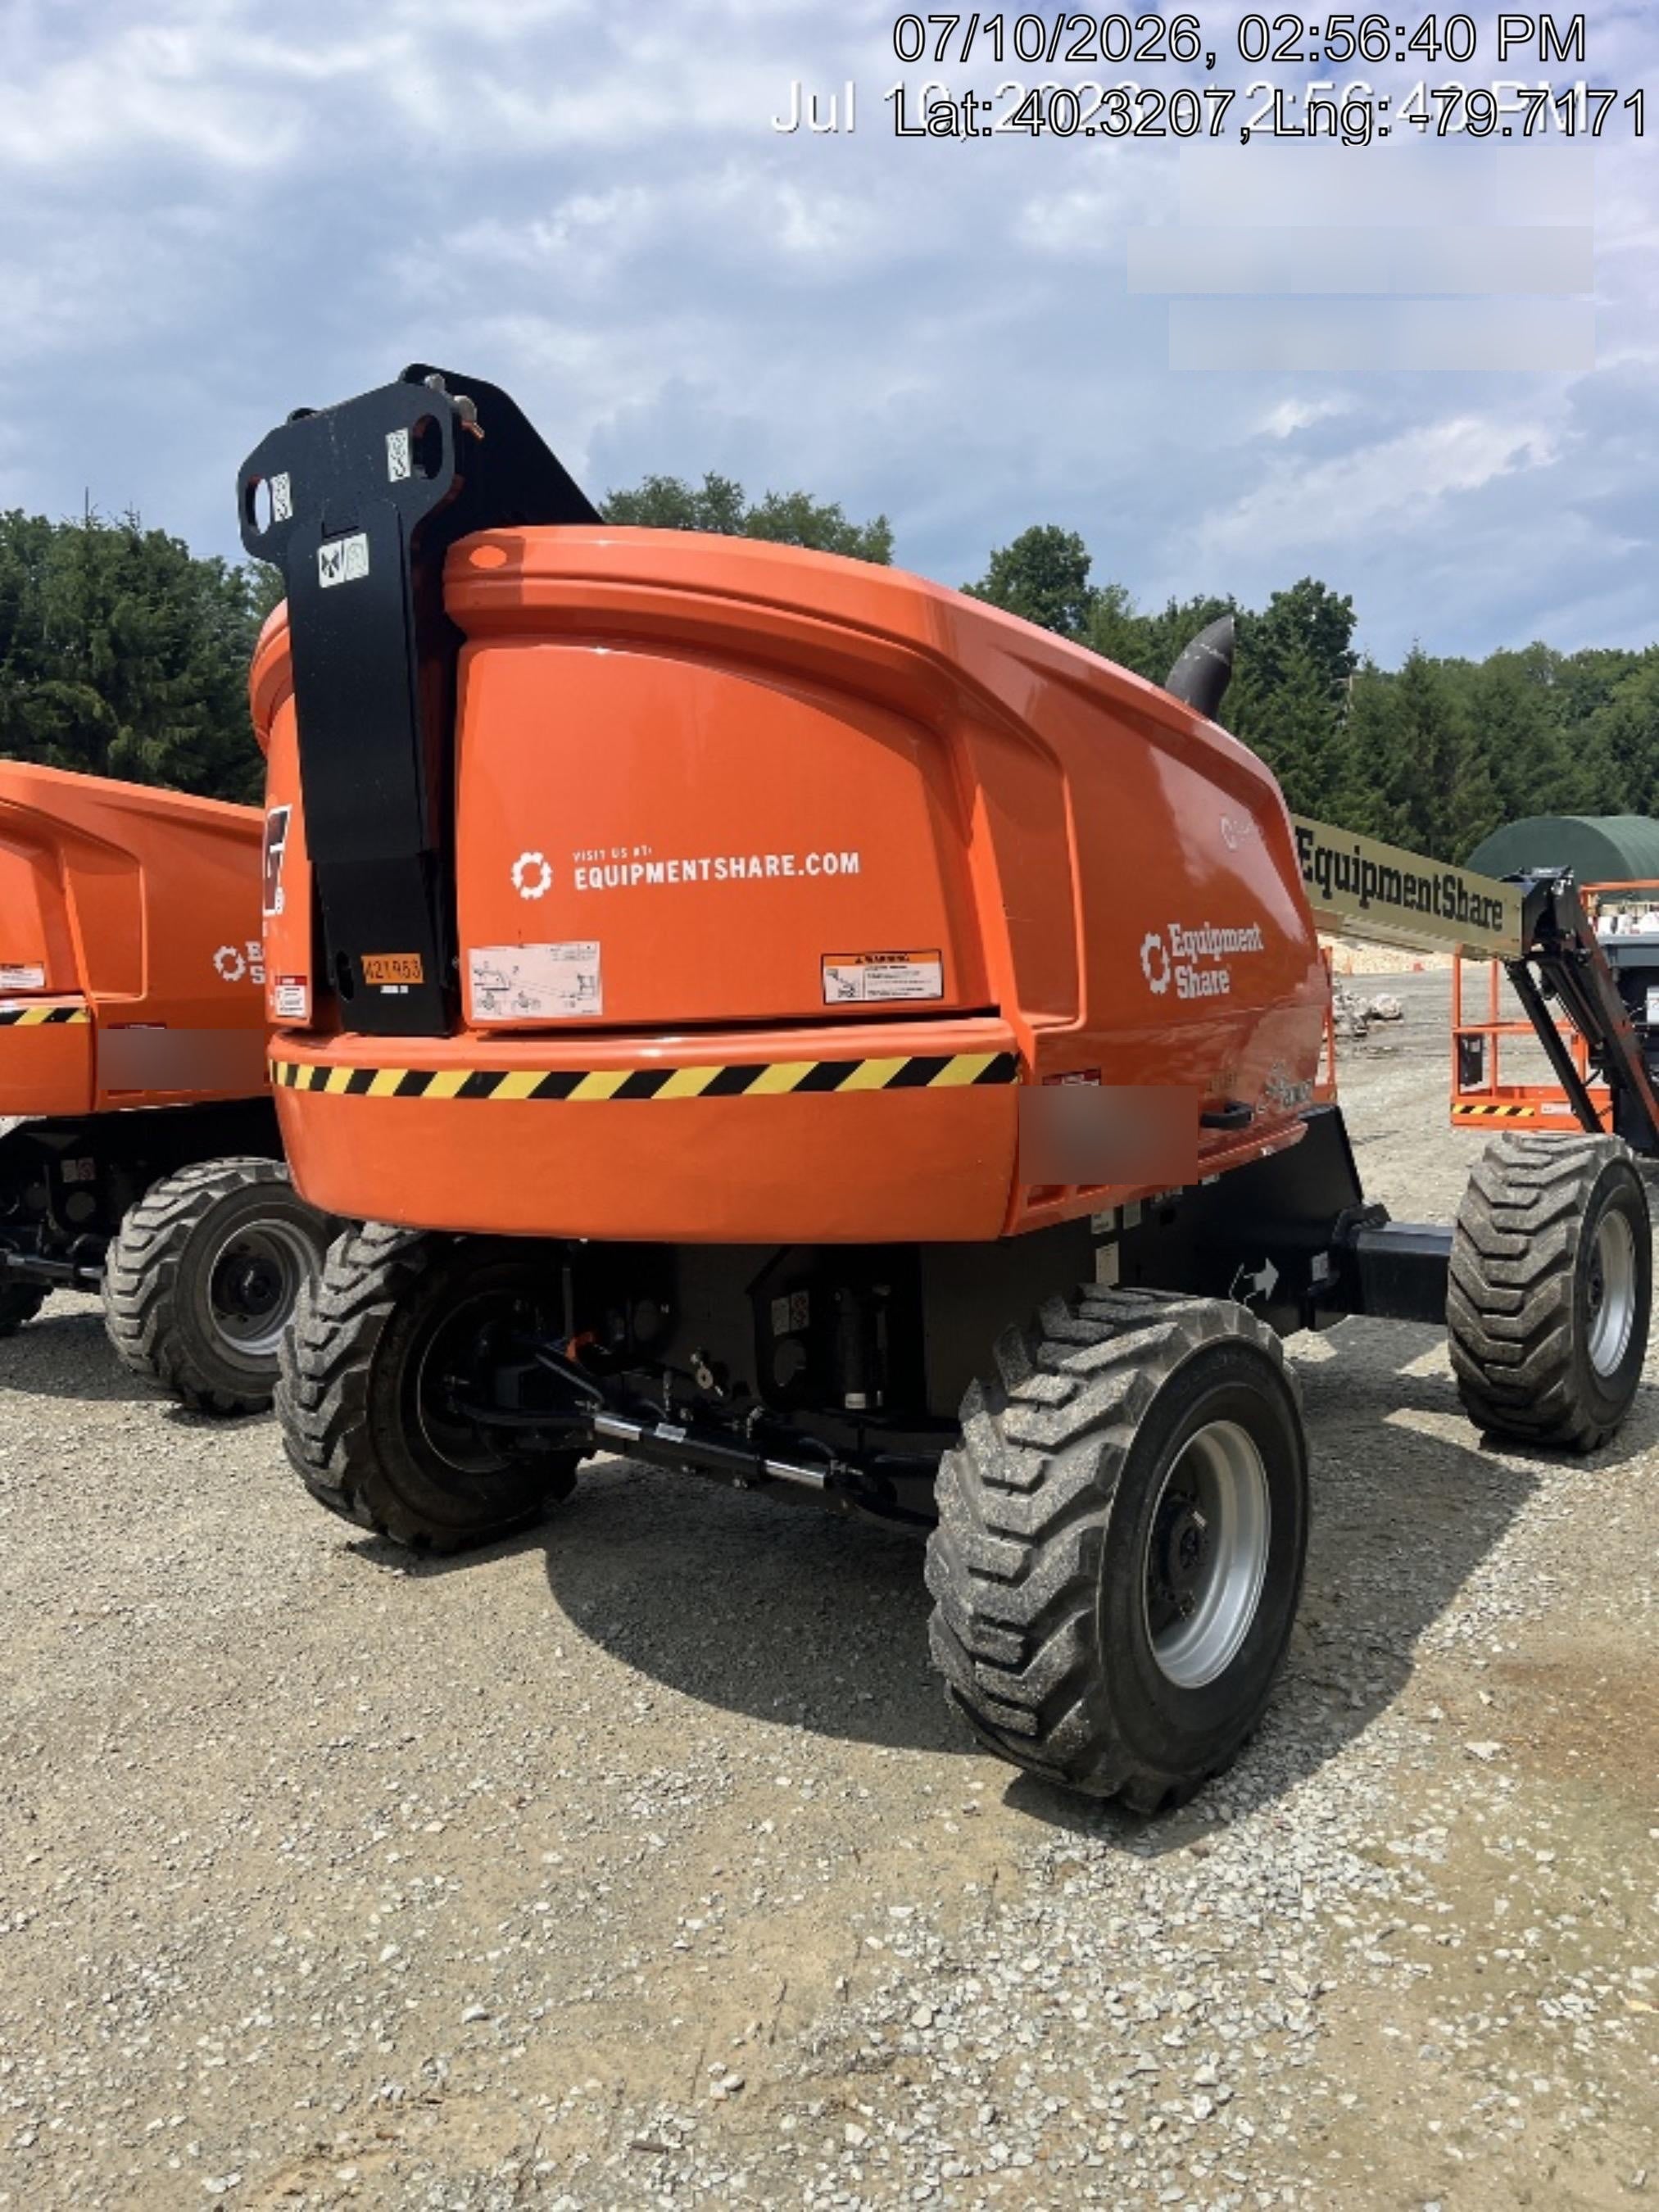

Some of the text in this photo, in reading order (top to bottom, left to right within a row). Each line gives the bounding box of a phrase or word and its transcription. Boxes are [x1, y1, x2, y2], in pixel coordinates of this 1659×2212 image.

[572, 849, 606, 863] VISIT
[611, 847, 628, 859] US
[574, 851, 861, 891] EQUIPMENTSHARE.COM
[1294, 825, 1504, 931] EquipmentShare
[1167, 921, 1264, 964] Equipment
[1175, 964, 1231, 999] Share
